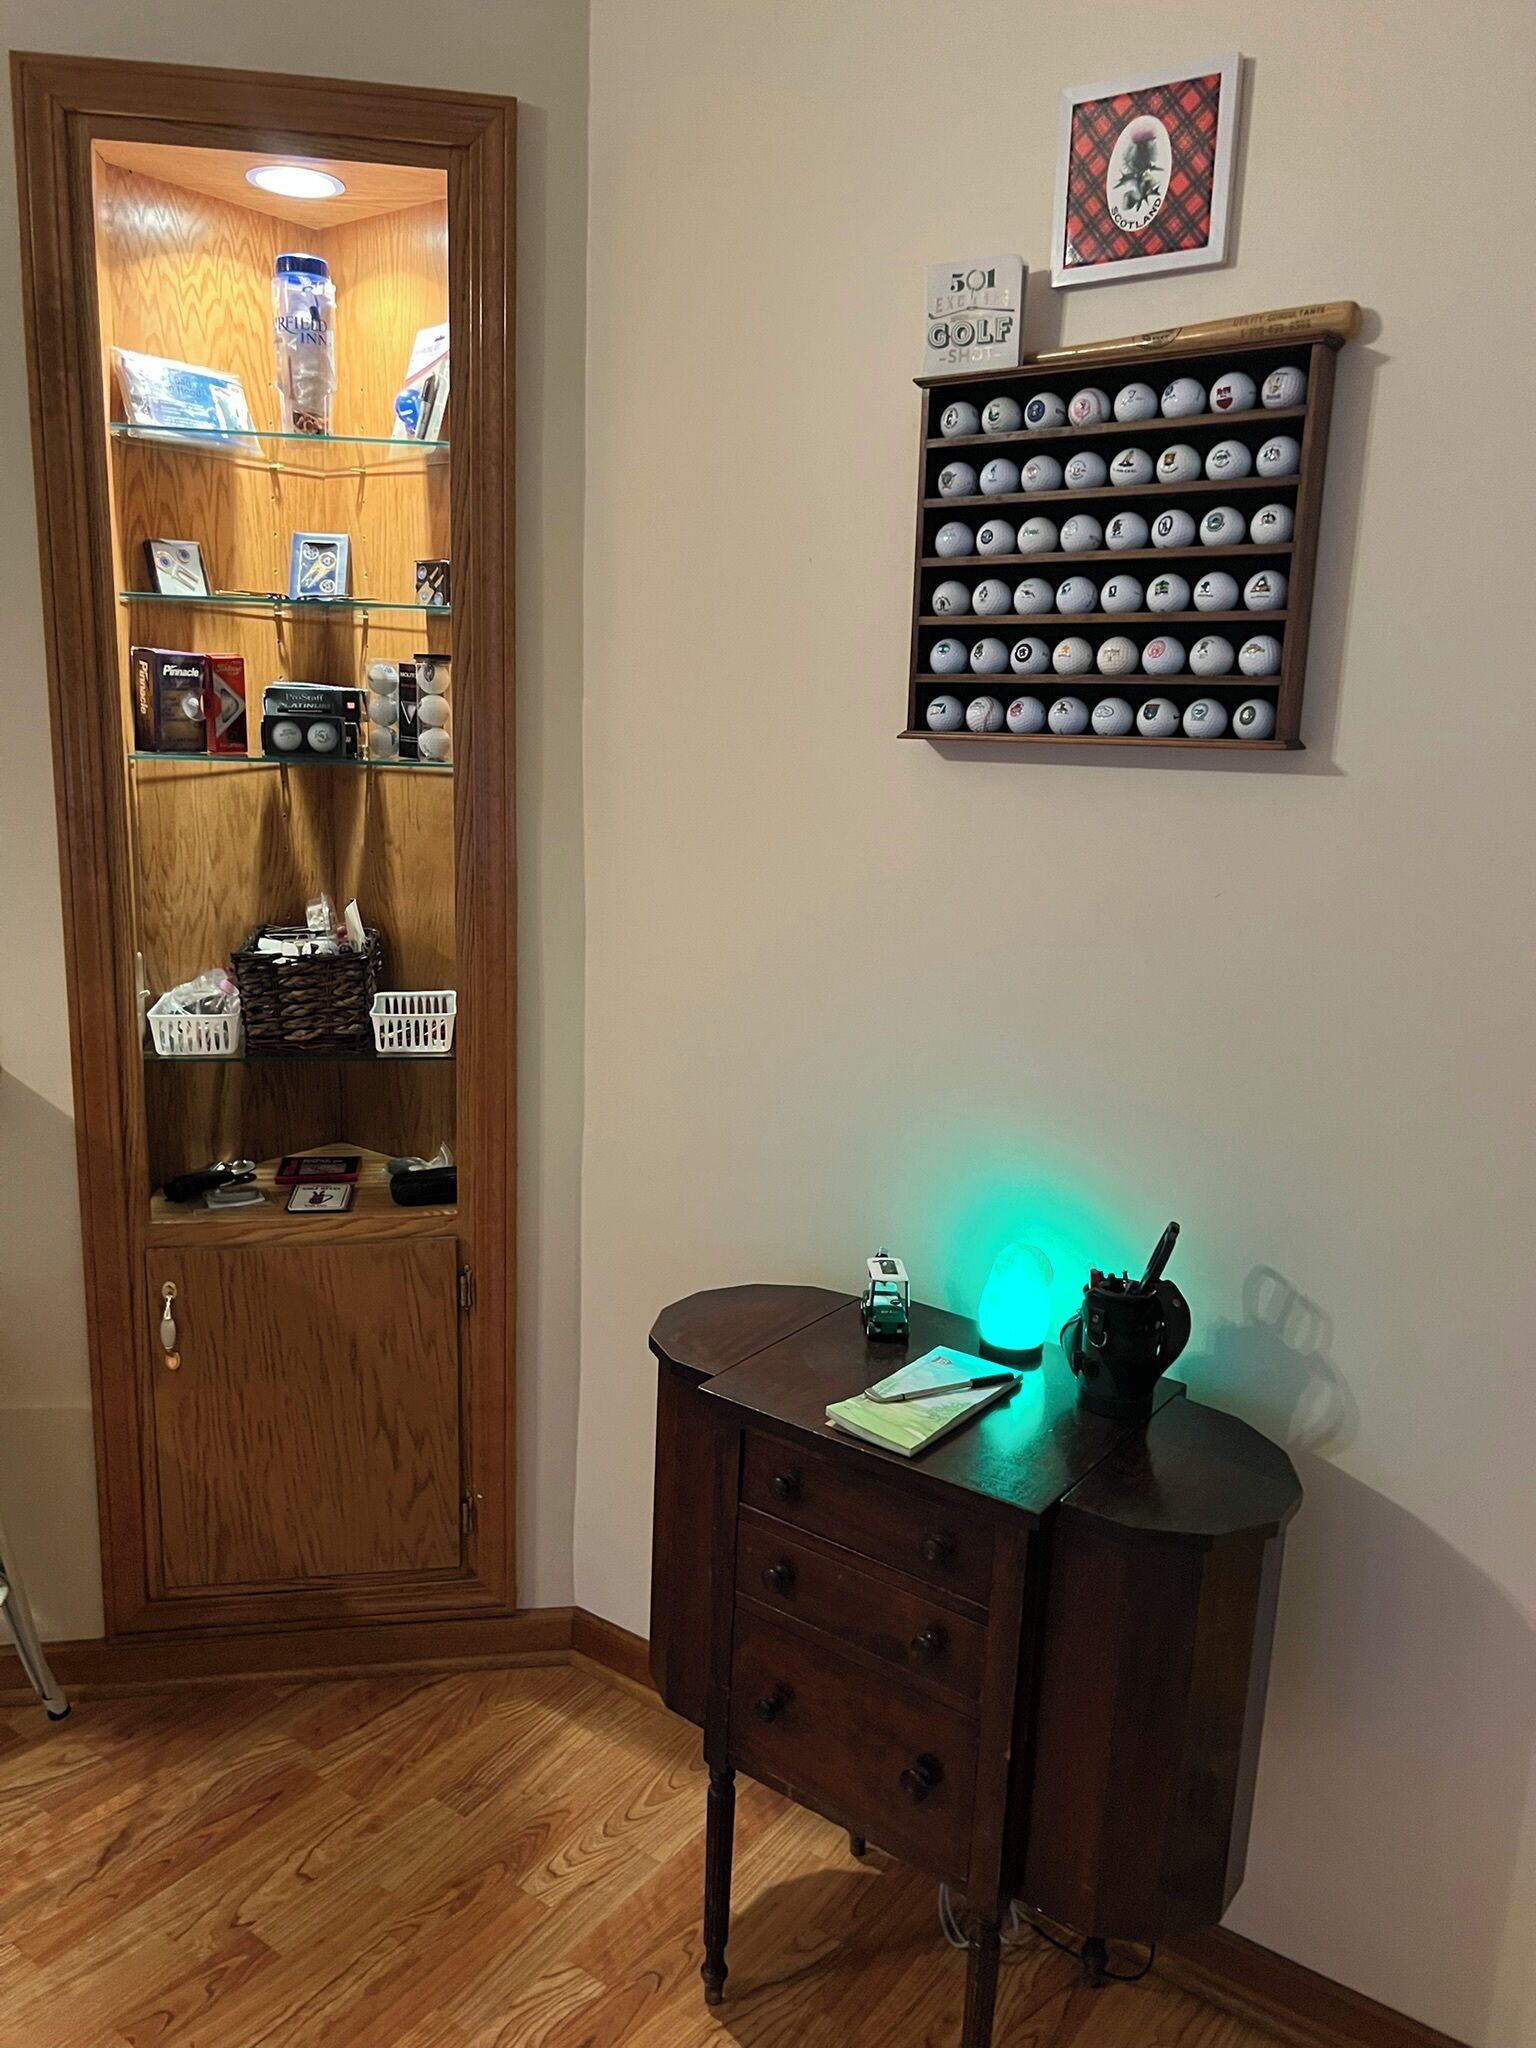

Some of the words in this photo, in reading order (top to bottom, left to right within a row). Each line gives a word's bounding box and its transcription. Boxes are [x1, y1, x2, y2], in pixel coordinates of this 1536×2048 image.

[1111, 197, 1162, 230] SCOTLAND
[950, 268, 996, 293] 501
[301, 332, 327, 345] INN
[927, 316, 1014, 349] GOLF
[163, 664, 200, 677] Pinnacle
[138, 660, 150, 715] Pinnacle
[285, 693, 325, 702] ProStaff
